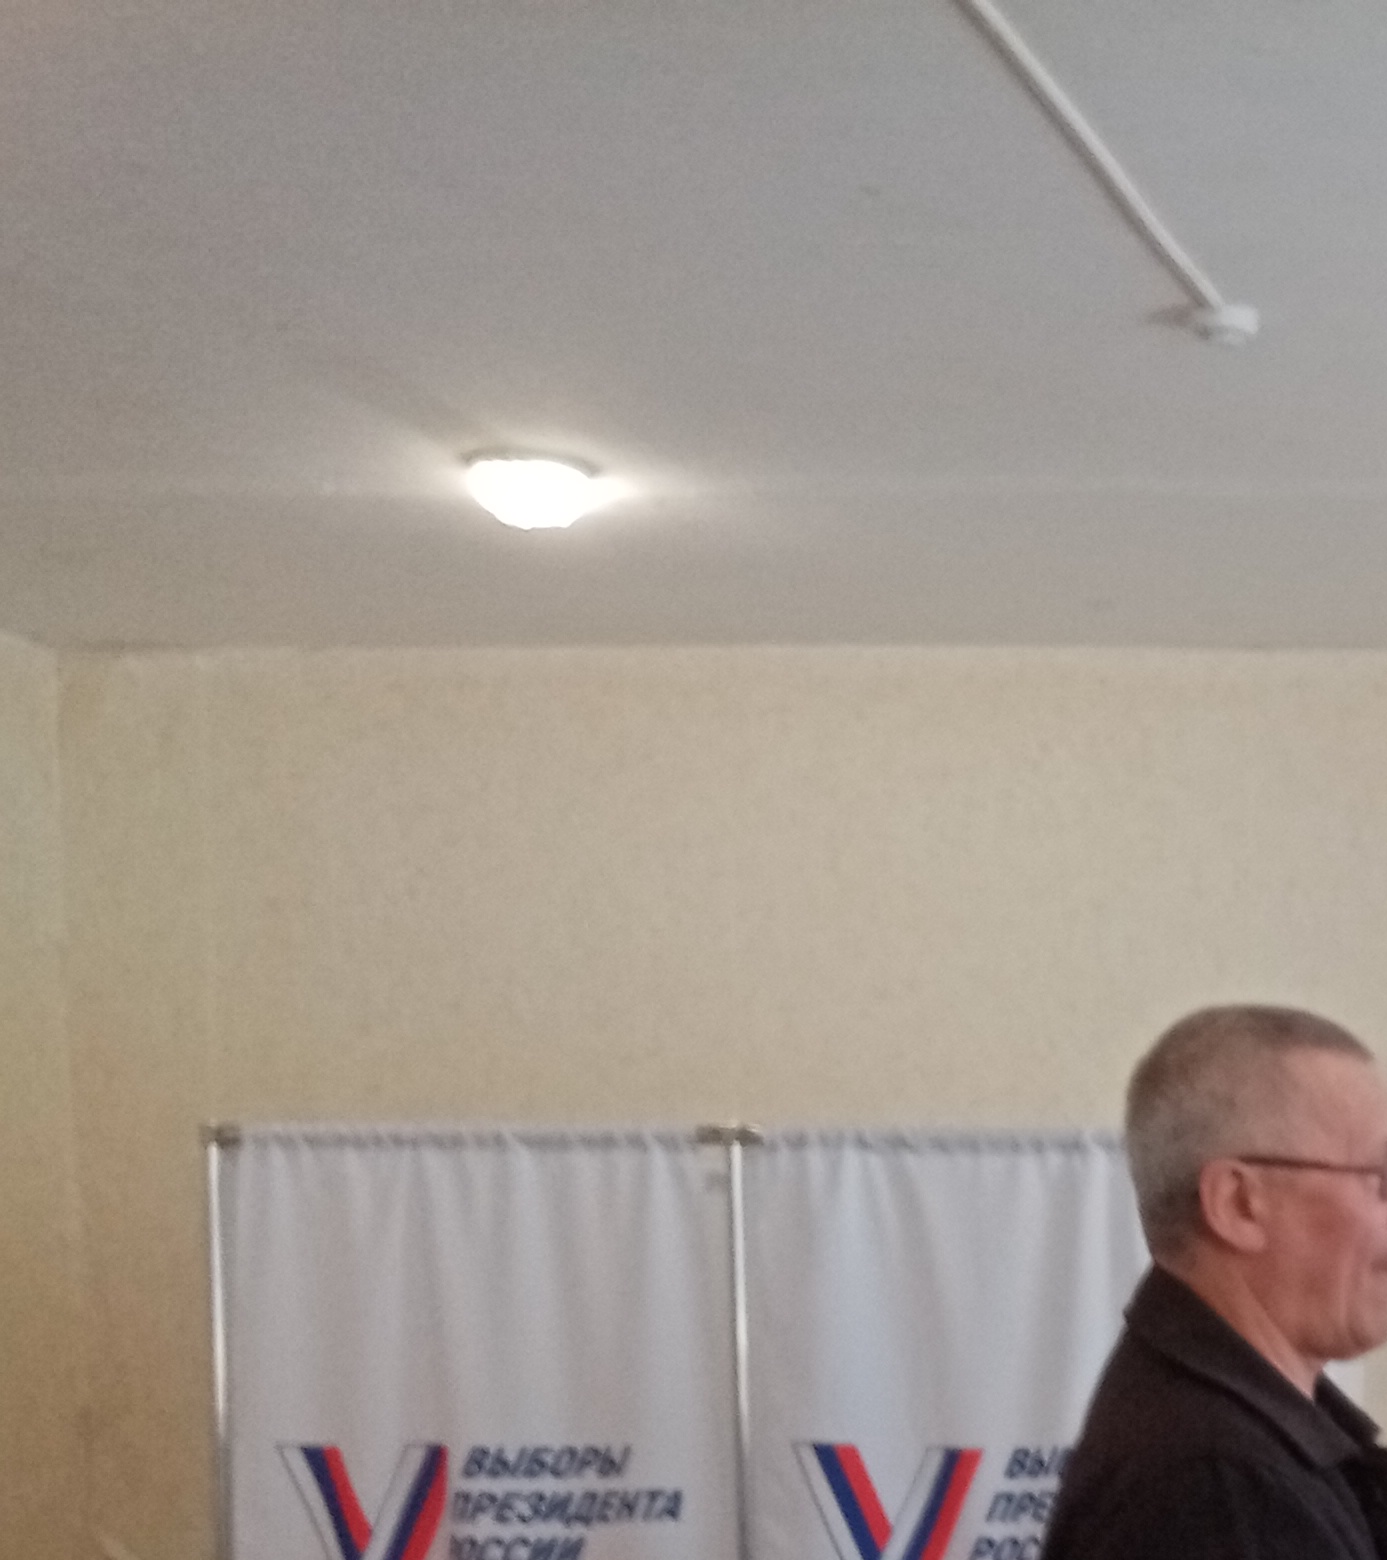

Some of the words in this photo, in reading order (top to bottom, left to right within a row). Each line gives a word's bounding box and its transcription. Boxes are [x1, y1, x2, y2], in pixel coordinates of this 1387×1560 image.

[462, 1444, 633, 1480] ВЫБОРЫ
[1004, 1446, 1070, 1480] ВЫ
[453, 1489, 683, 1527] ПРЕЗИДЕНТА
[985, 1491, 1053, 1524] ПРЕ
